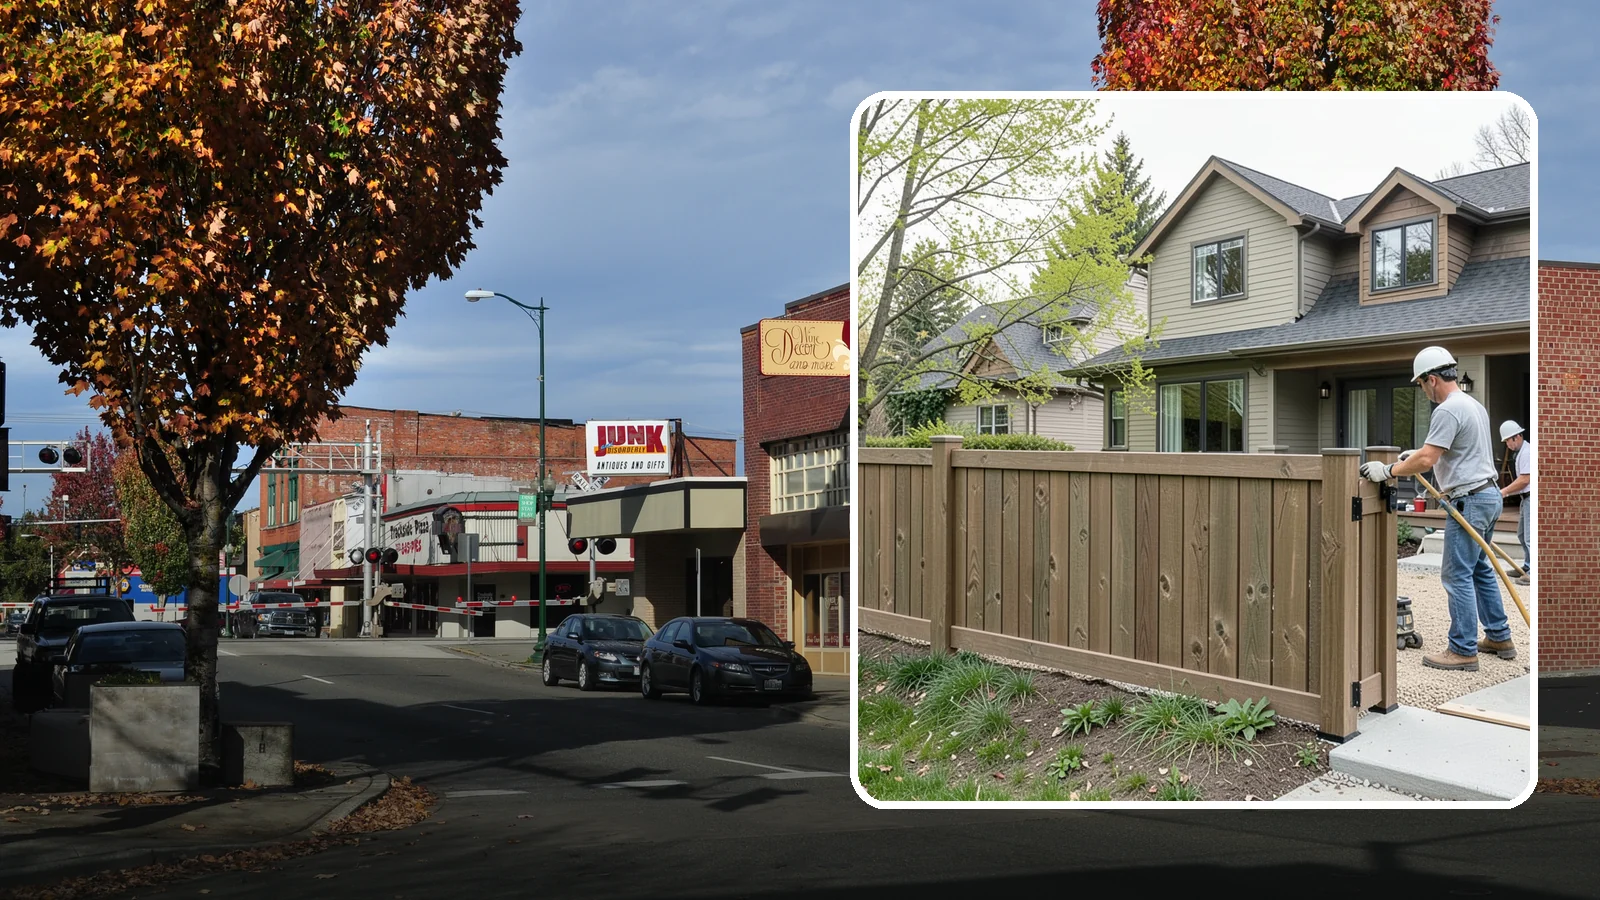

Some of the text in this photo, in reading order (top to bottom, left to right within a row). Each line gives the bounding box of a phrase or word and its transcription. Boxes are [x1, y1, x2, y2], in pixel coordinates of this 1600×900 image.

[596, 426, 665, 457] JUNK
[607, 446, 646, 454] DISORDERLY
[597, 460, 666, 470] ANTIQUES AND GIFTS
[390, 520, 429, 539] Trackside Pizza
